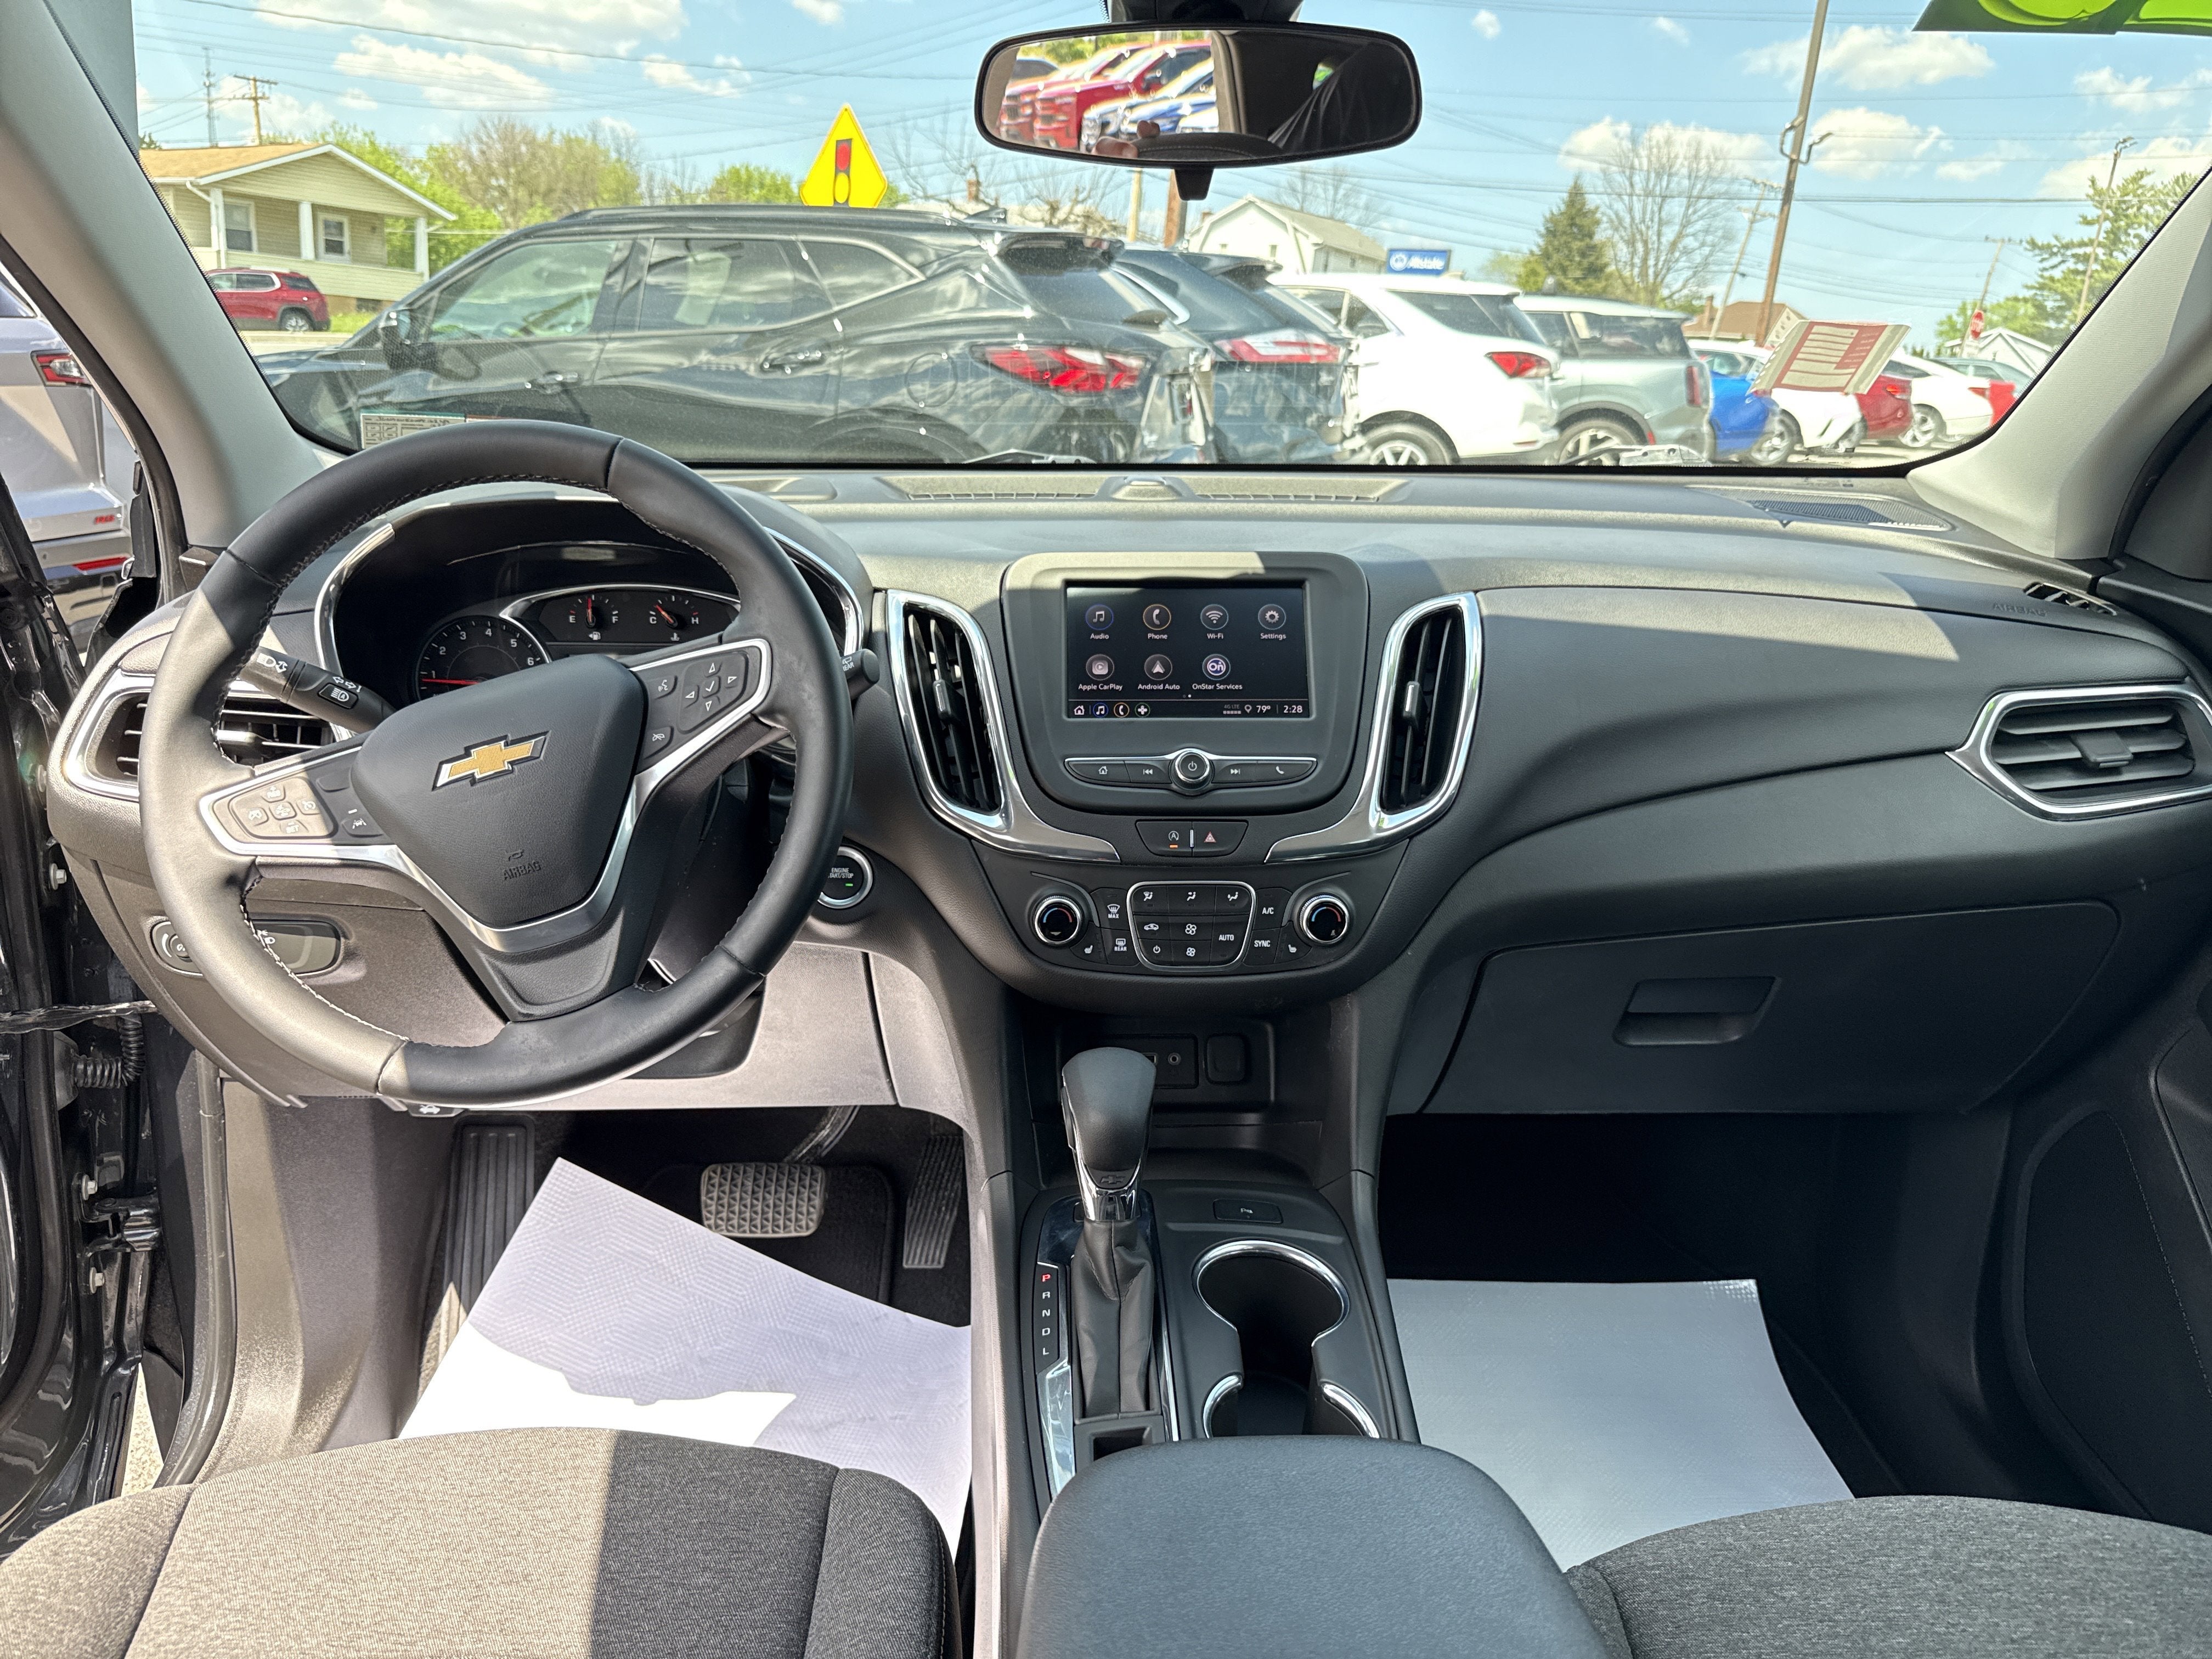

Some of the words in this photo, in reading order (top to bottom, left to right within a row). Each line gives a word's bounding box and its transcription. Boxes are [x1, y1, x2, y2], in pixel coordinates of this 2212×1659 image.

[460, 631, 467, 640] 3
[486, 628, 492, 637] 4
[511, 639, 517, 648] 5
[439, 646, 447, 655] 2
[527, 657, 534, 665] 6
[431, 670, 436, 679] 1
[1256, 705, 1271, 713] 79°
[1283, 705, 1303, 713] 2:28
[504, 861, 541, 881] AIRBAG
[1042, 1274, 1051, 1282] P
[1042, 1327, 1051, 1336] D
